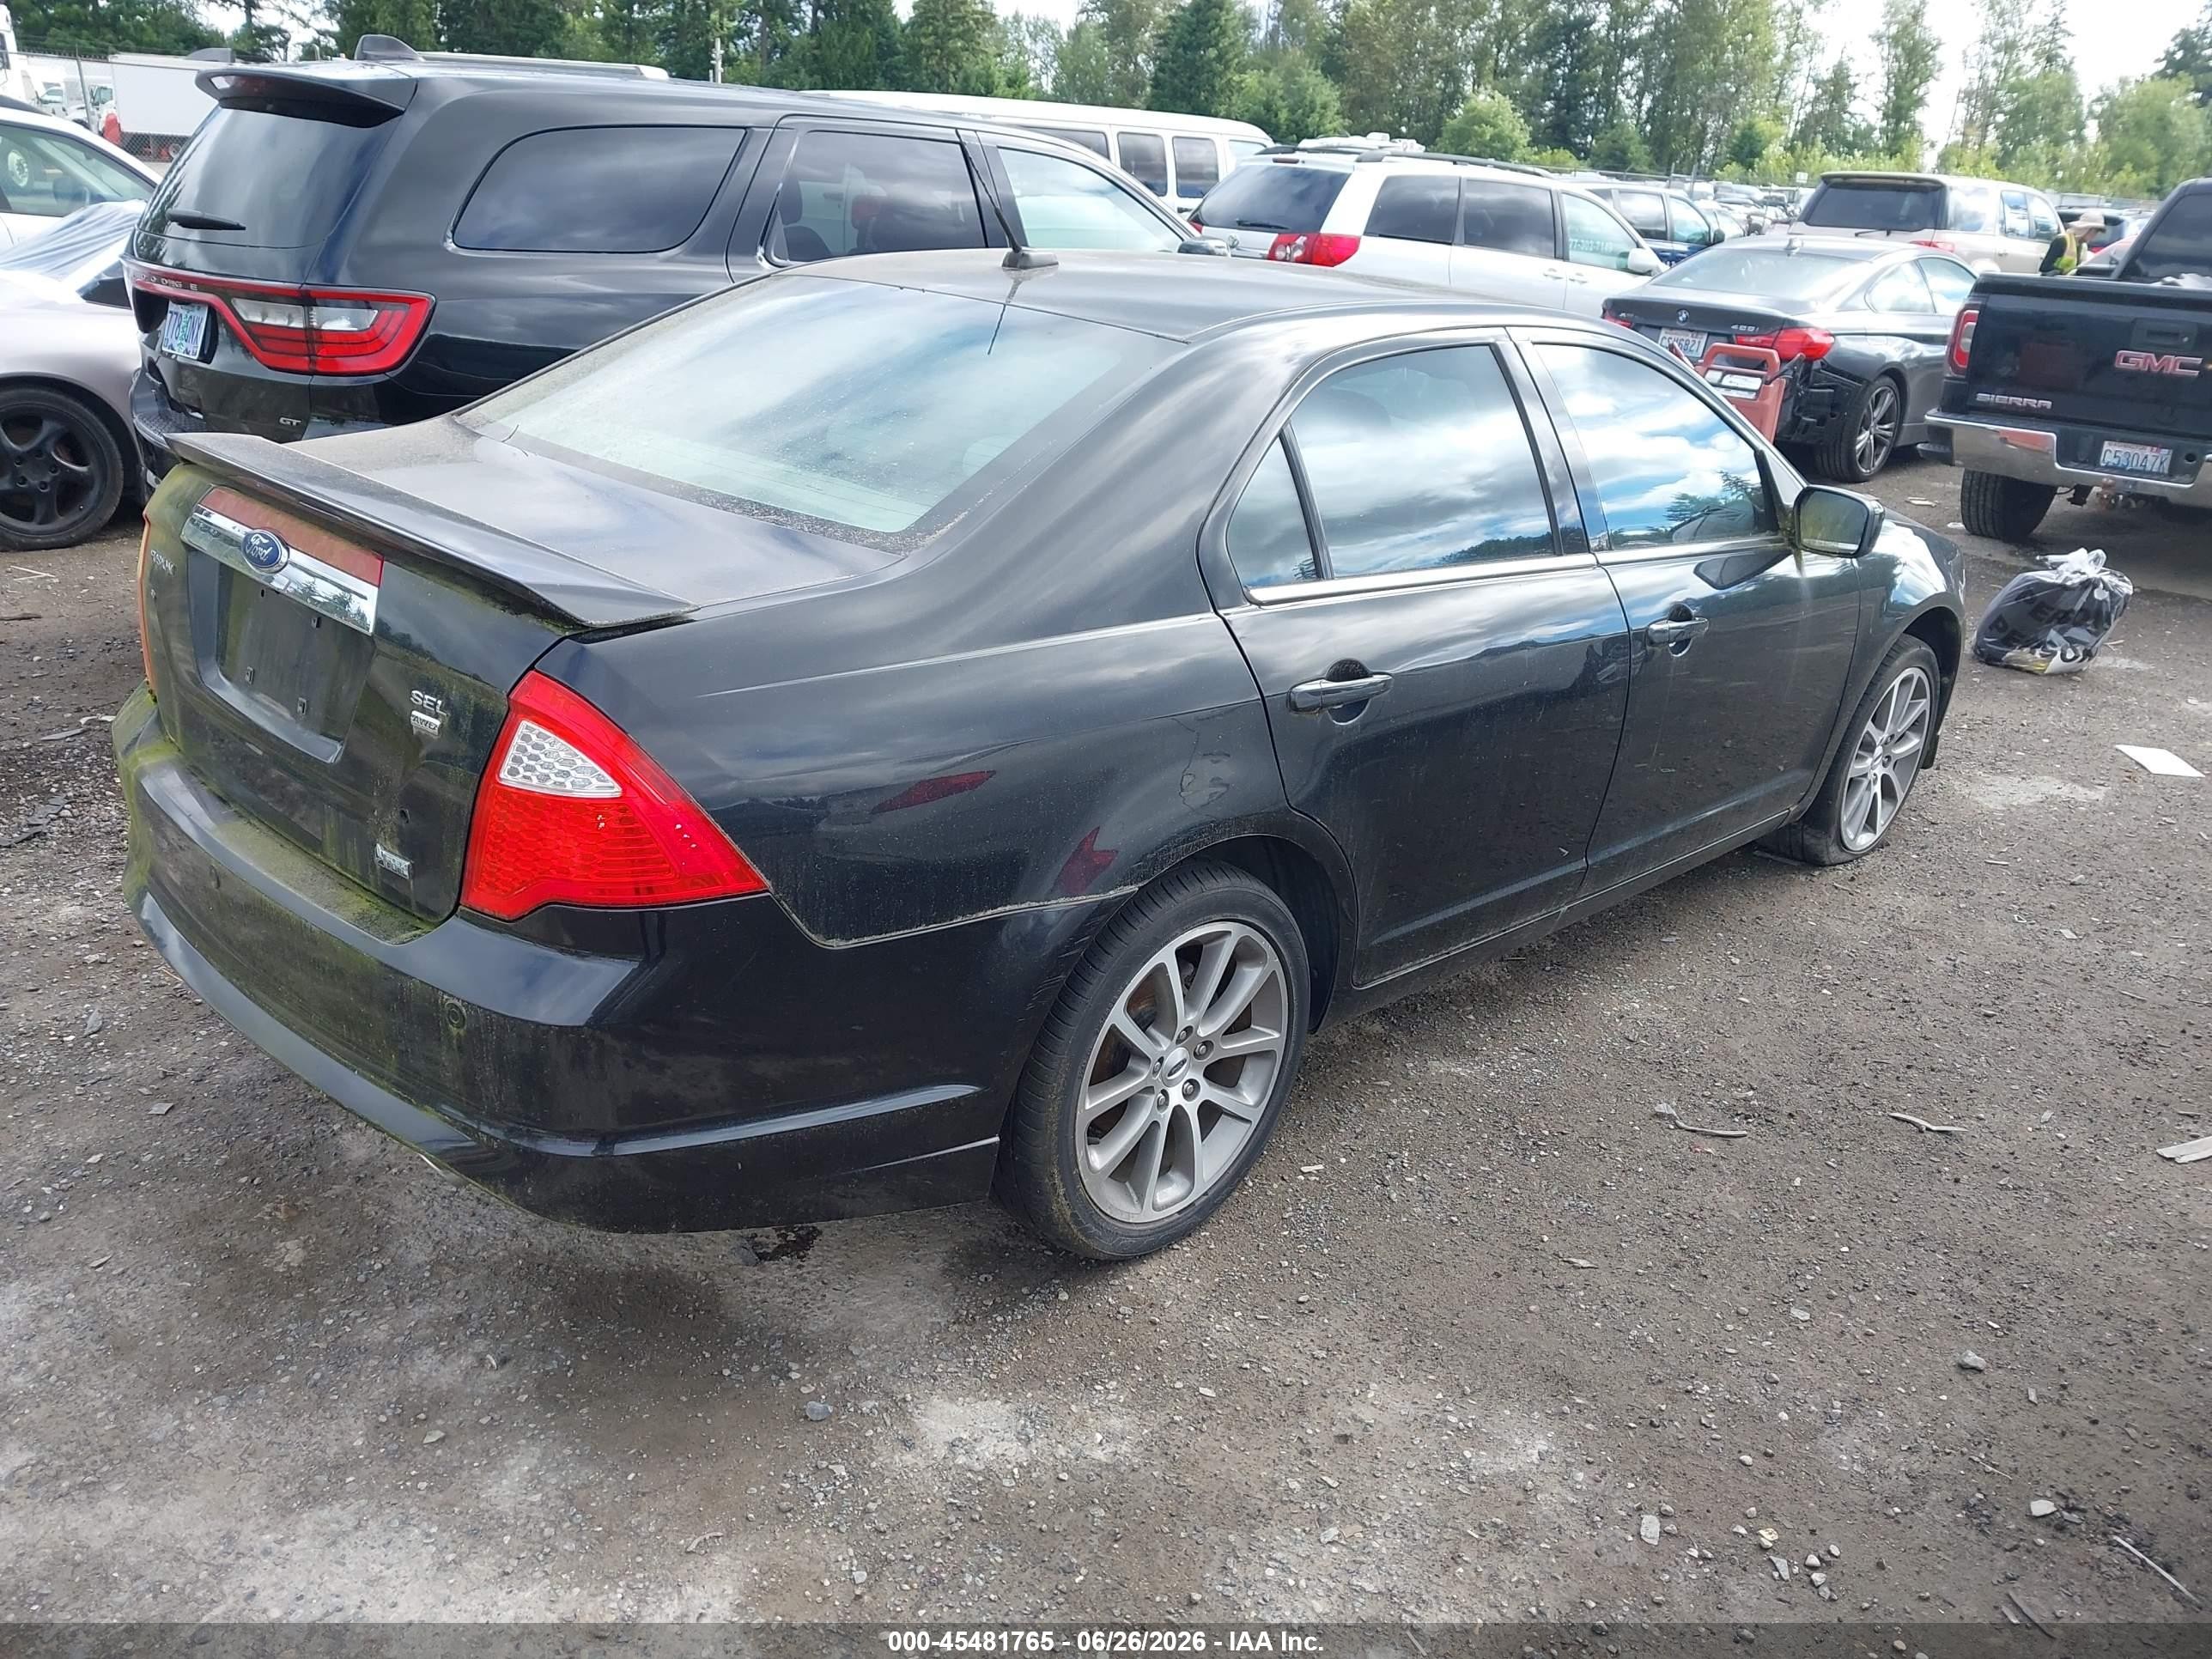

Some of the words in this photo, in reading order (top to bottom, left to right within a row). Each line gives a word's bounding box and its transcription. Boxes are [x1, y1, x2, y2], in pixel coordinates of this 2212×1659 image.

[2115, 350, 2203, 376] GMC
[1976, 392, 2052, 410] SIERRA
[279, 416, 301, 426] GT
[2102, 448, 2168, 473] C53047K
[246, 533, 273, 562] Ford
[410, 690, 447, 715] SEL
